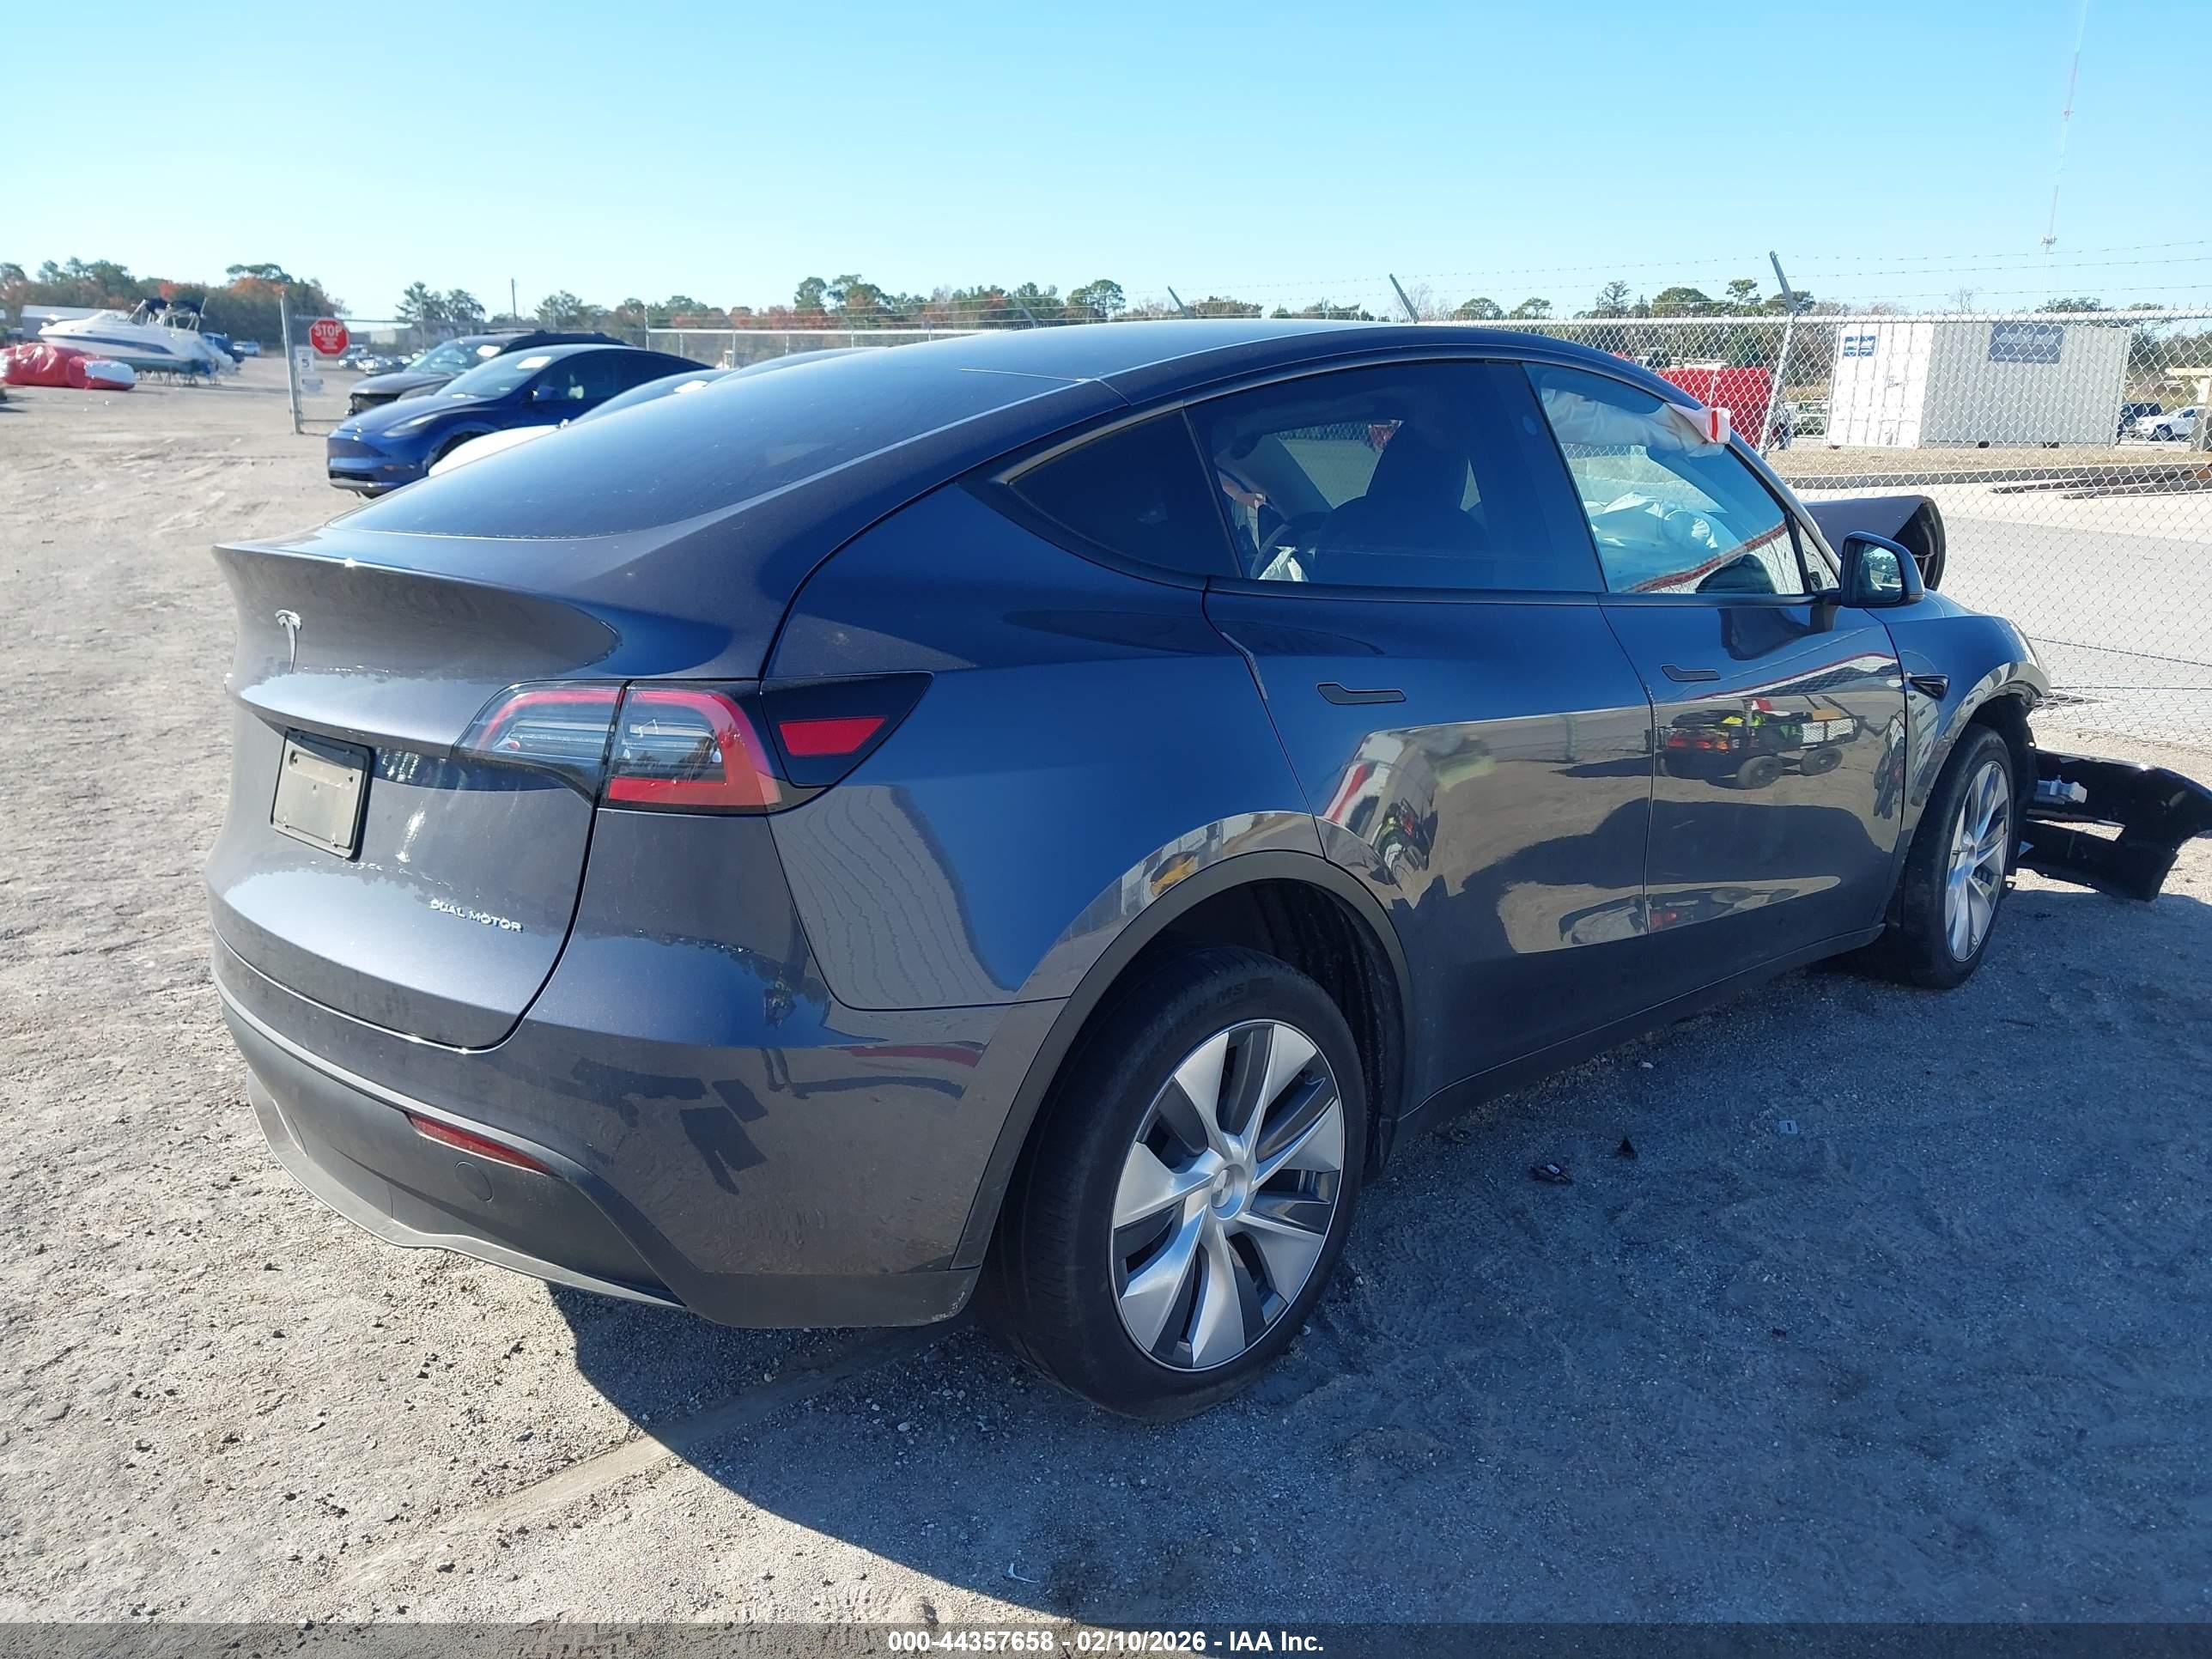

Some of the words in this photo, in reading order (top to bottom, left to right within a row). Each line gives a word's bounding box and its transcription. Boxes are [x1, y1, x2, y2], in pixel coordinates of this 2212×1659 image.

[314, 324, 342, 337] STOP
[429, 898, 466, 919] DUAL
[468, 910, 523, 933] MOTOR
